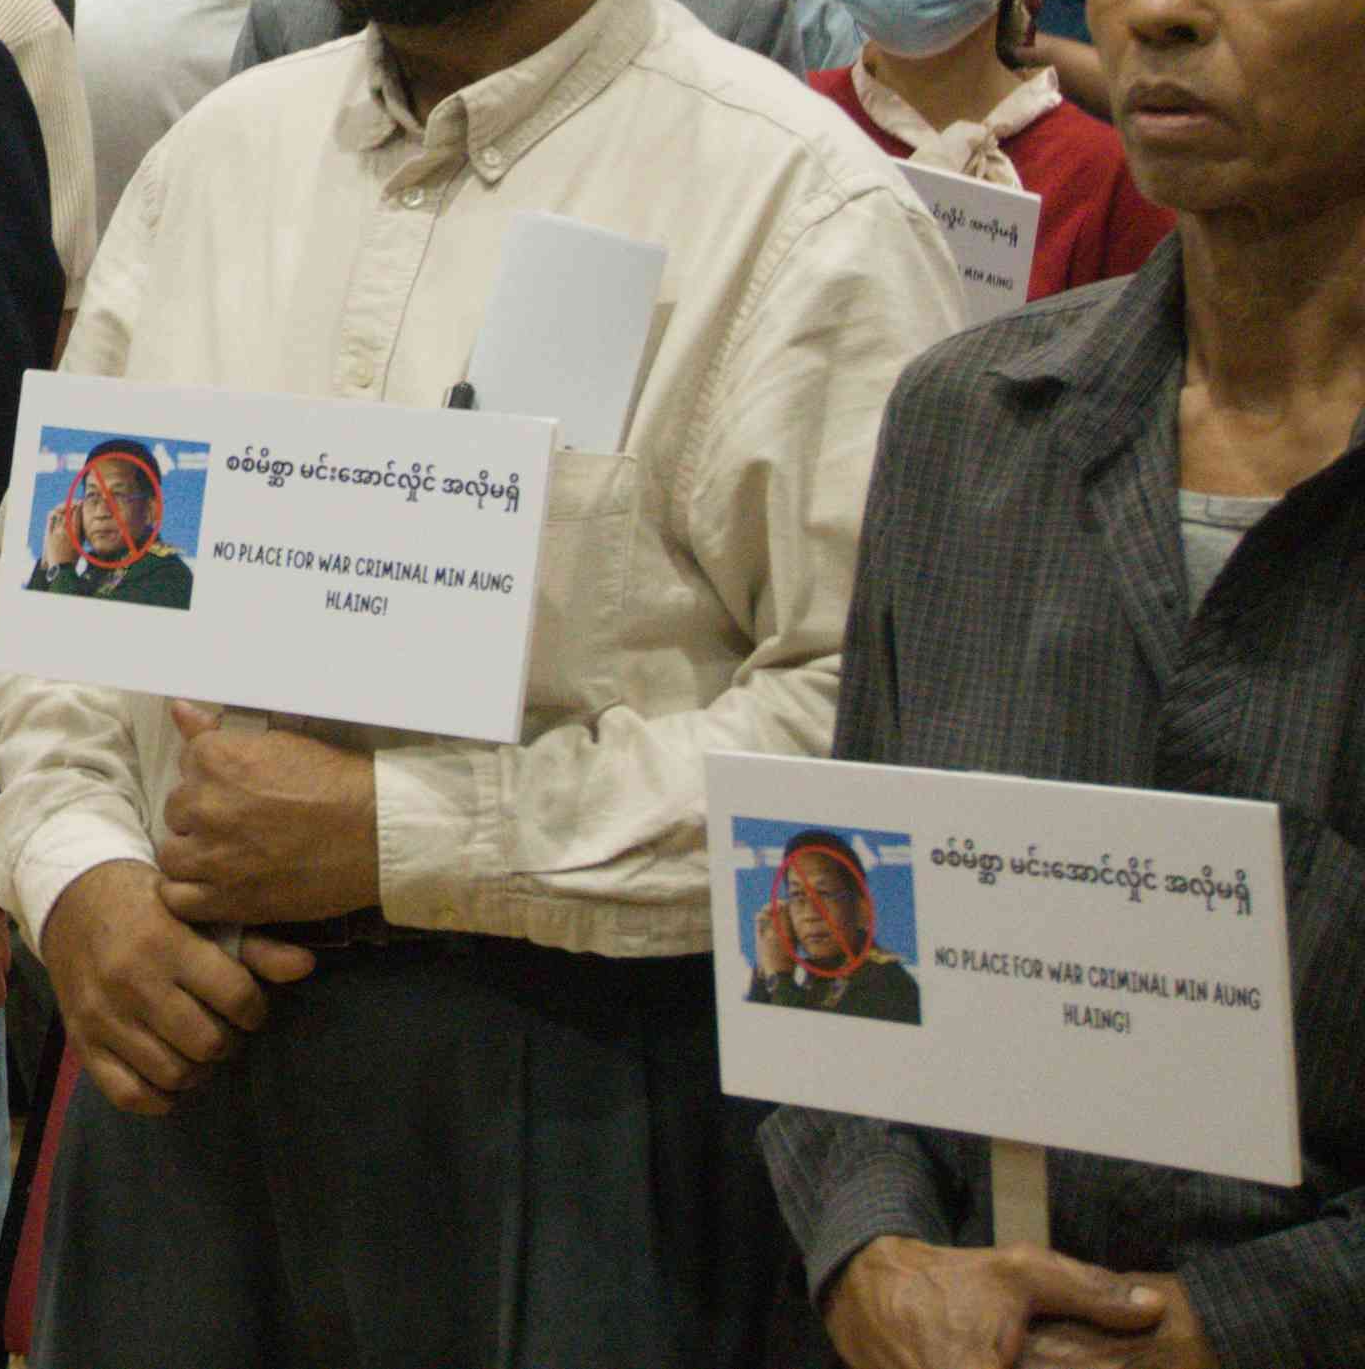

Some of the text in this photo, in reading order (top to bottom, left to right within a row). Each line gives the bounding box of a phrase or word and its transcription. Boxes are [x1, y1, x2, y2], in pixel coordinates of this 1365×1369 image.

[443, 470, 520, 513] အလိုမရှိ
[214, 542, 513, 594] NO PLACE FOR WAR CRIMINAL MIN AUNG
[326, 590, 388, 616] HLAING!
[934, 947, 1260, 1011] NO PLACE FOR WAR CRIMINAL MIN AUNG
[1064, 1003, 1130, 1034] HLAING!
